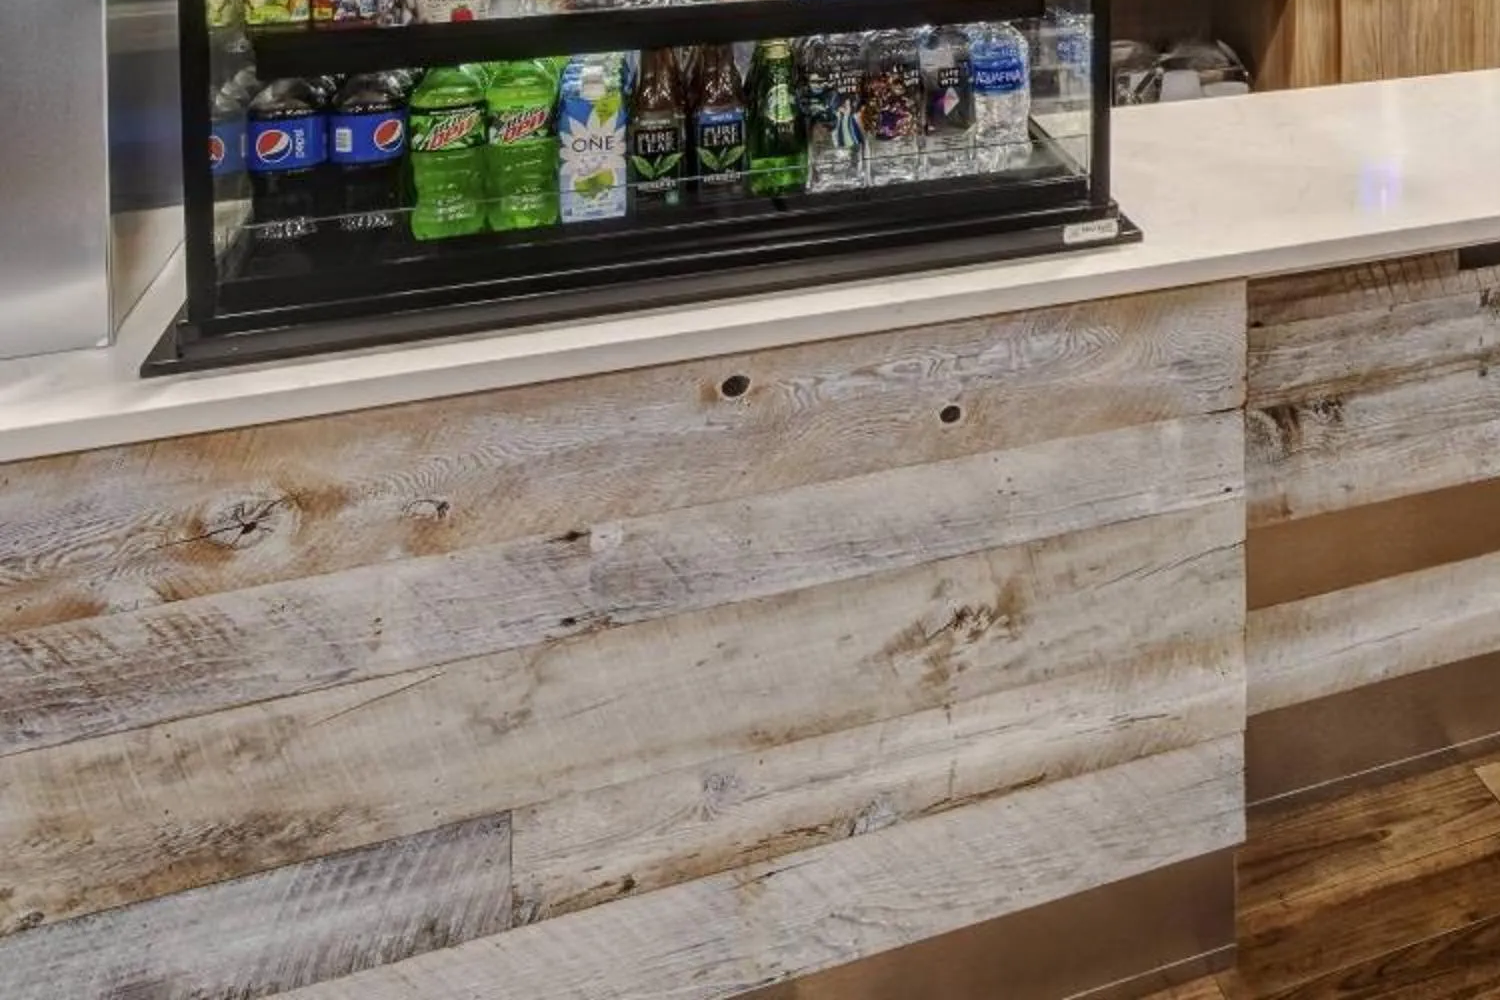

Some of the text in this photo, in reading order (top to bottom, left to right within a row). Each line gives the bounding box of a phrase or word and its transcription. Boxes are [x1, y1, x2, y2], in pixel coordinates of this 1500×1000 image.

[975, 69, 1024, 85] AQUAFINA
[637, 130, 674, 143] PURE
[703, 123, 738, 137] PURE
[572, 135, 616, 153] ONE
[703, 133, 740, 147] LEAF
